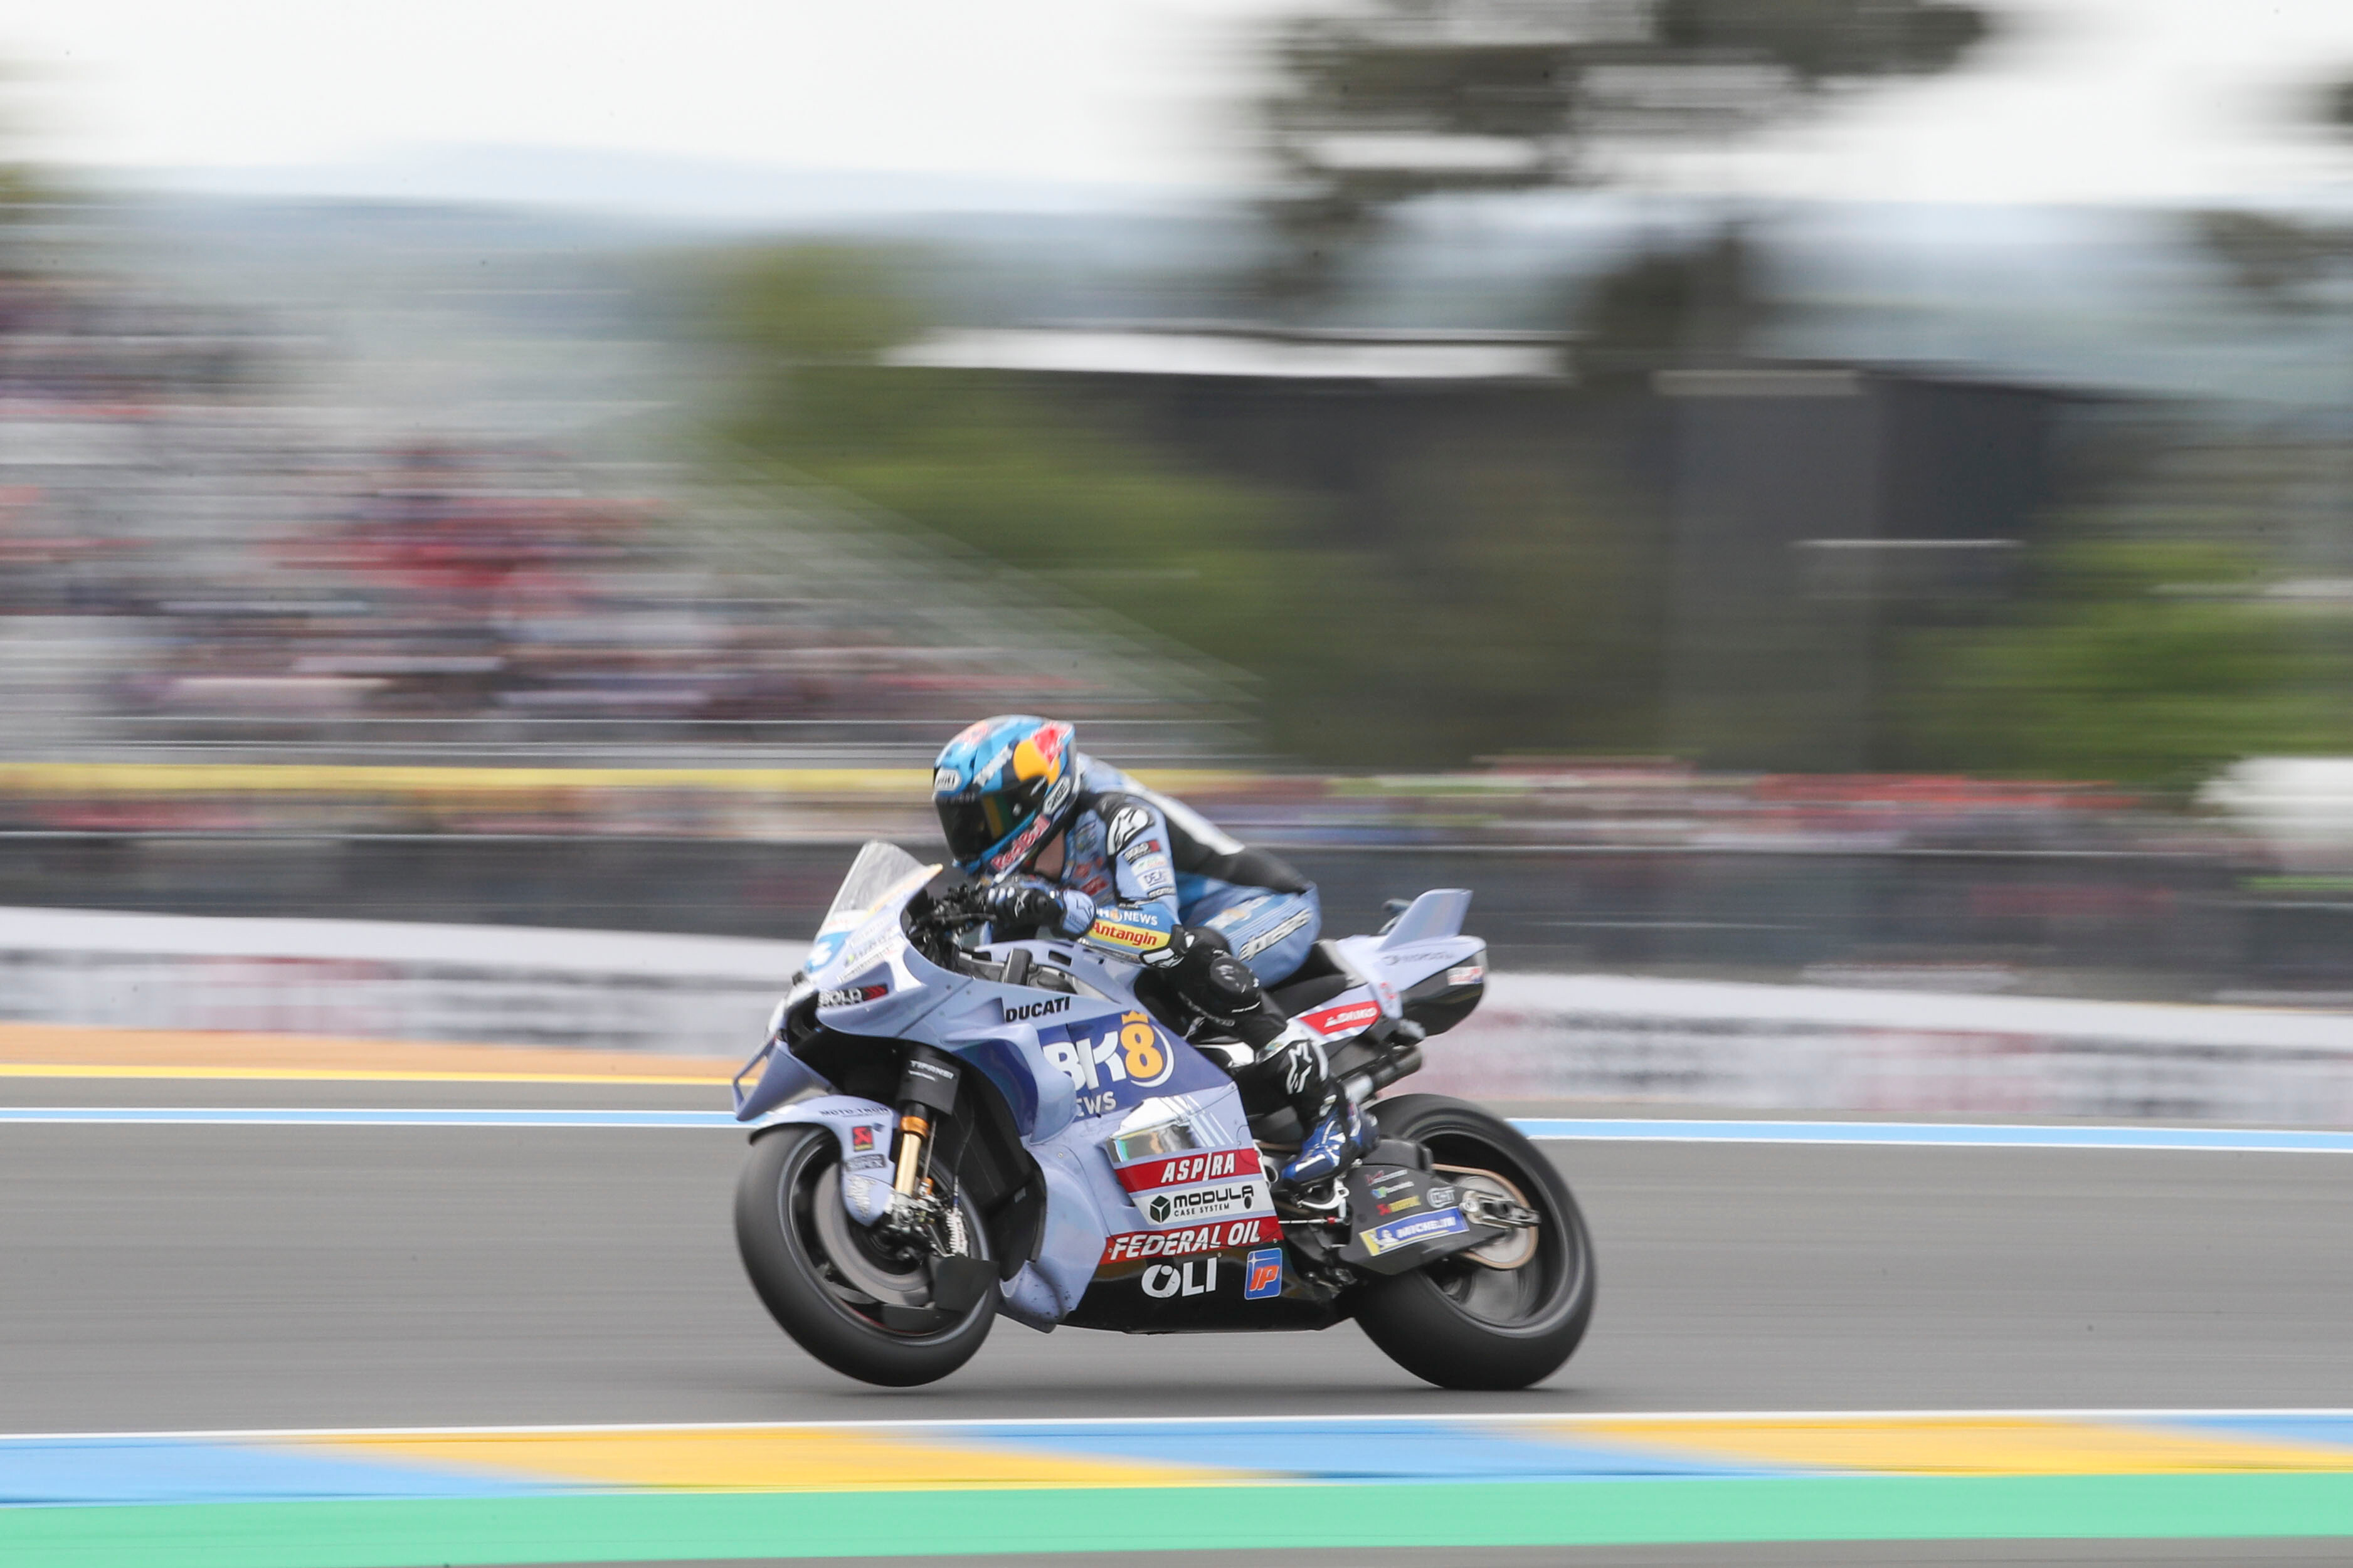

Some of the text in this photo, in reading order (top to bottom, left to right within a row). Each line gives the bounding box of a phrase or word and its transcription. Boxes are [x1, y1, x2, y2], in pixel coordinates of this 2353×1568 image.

[1123, 910, 1158, 926] NEWS
[1092, 922, 1158, 946] Antangin
[1005, 996, 1071, 1023] DUCATI
[1042, 1023, 1163, 1091] BK8
[1076, 1091, 1116, 1117] EWS
[1160, 1152, 1235, 1184] ASPIRA
[1173, 1185, 1254, 1209] MODULA
[1174, 1202, 1230, 1217] CASE SYSTEM
[1109, 1220, 1261, 1261] FEDERAL OIL
[1395, 1216, 1456, 1239] MICHELIN
[1141, 1257, 1217, 1298] OLI
[1249, 1265, 1280, 1292] IP
